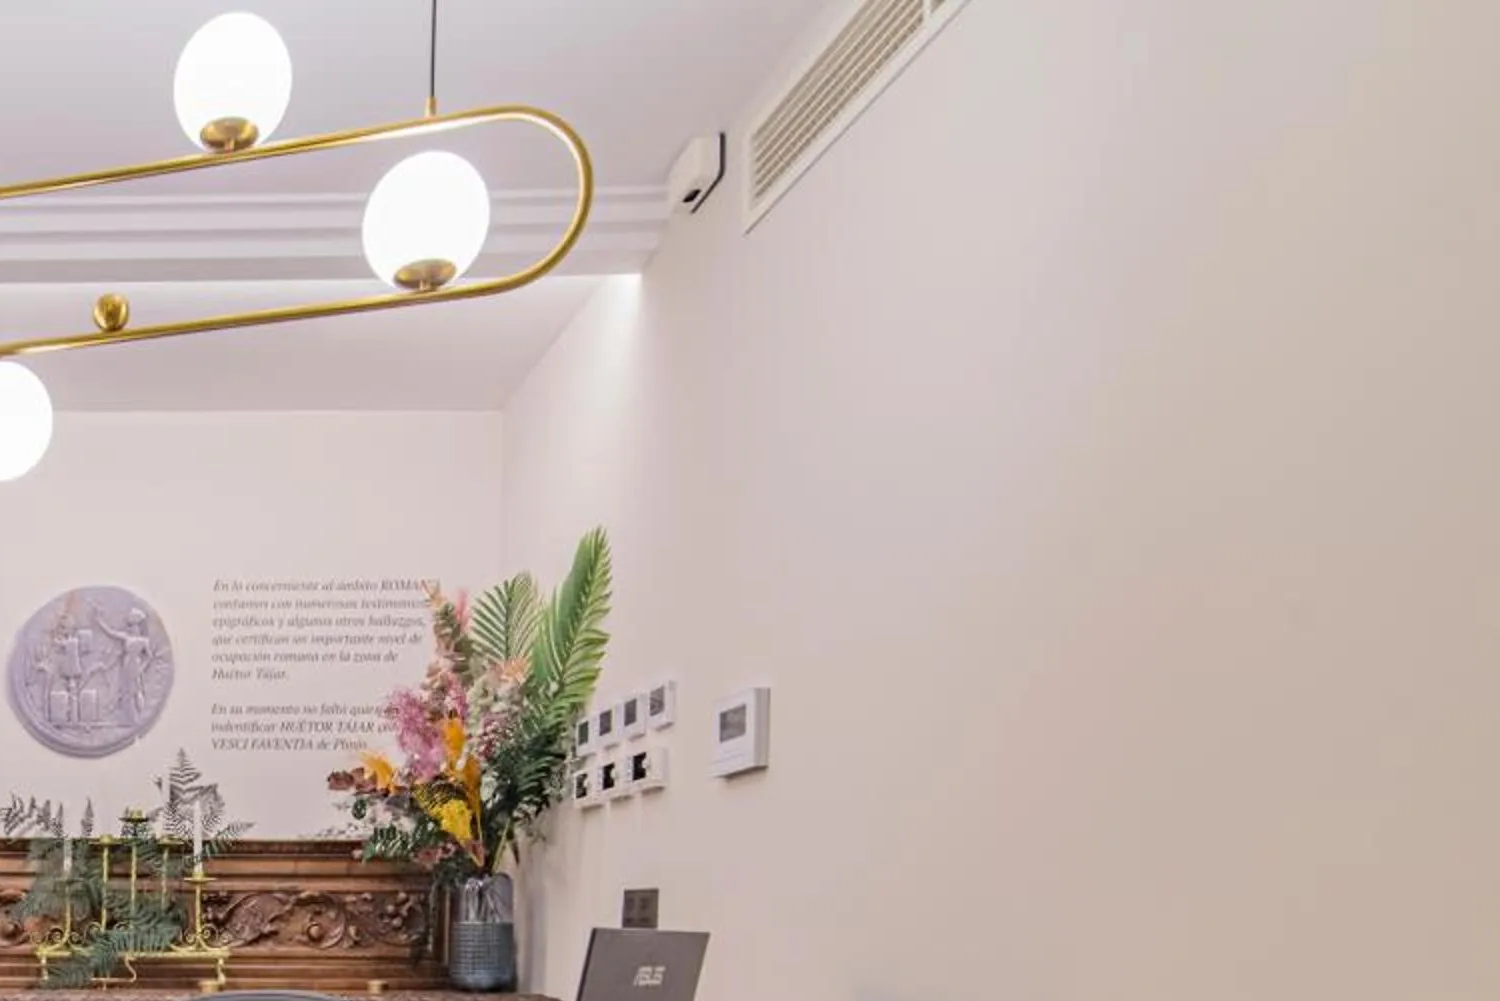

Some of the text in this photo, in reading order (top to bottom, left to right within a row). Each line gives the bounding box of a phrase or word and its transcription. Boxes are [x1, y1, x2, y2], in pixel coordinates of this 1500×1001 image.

[213, 579, 229, 591] En
[271, 599, 293, 609] con
[335, 616, 365, 629] otros
[211, 633, 232, 646] que
[292, 633, 307, 646] un
[311, 633, 374, 646] importante
[377, 633, 406, 646] nivel
[408, 633, 423, 646] de
[211, 650, 399, 664] ocupación romana en la zona de
[211, 703, 227, 716] En
[229, 703, 243, 716] su
[303, 703, 318, 716] no
[211, 738, 249, 751] VESCI
[317, 738, 328, 751] de
[633, 965, 667, 986] ASUS
